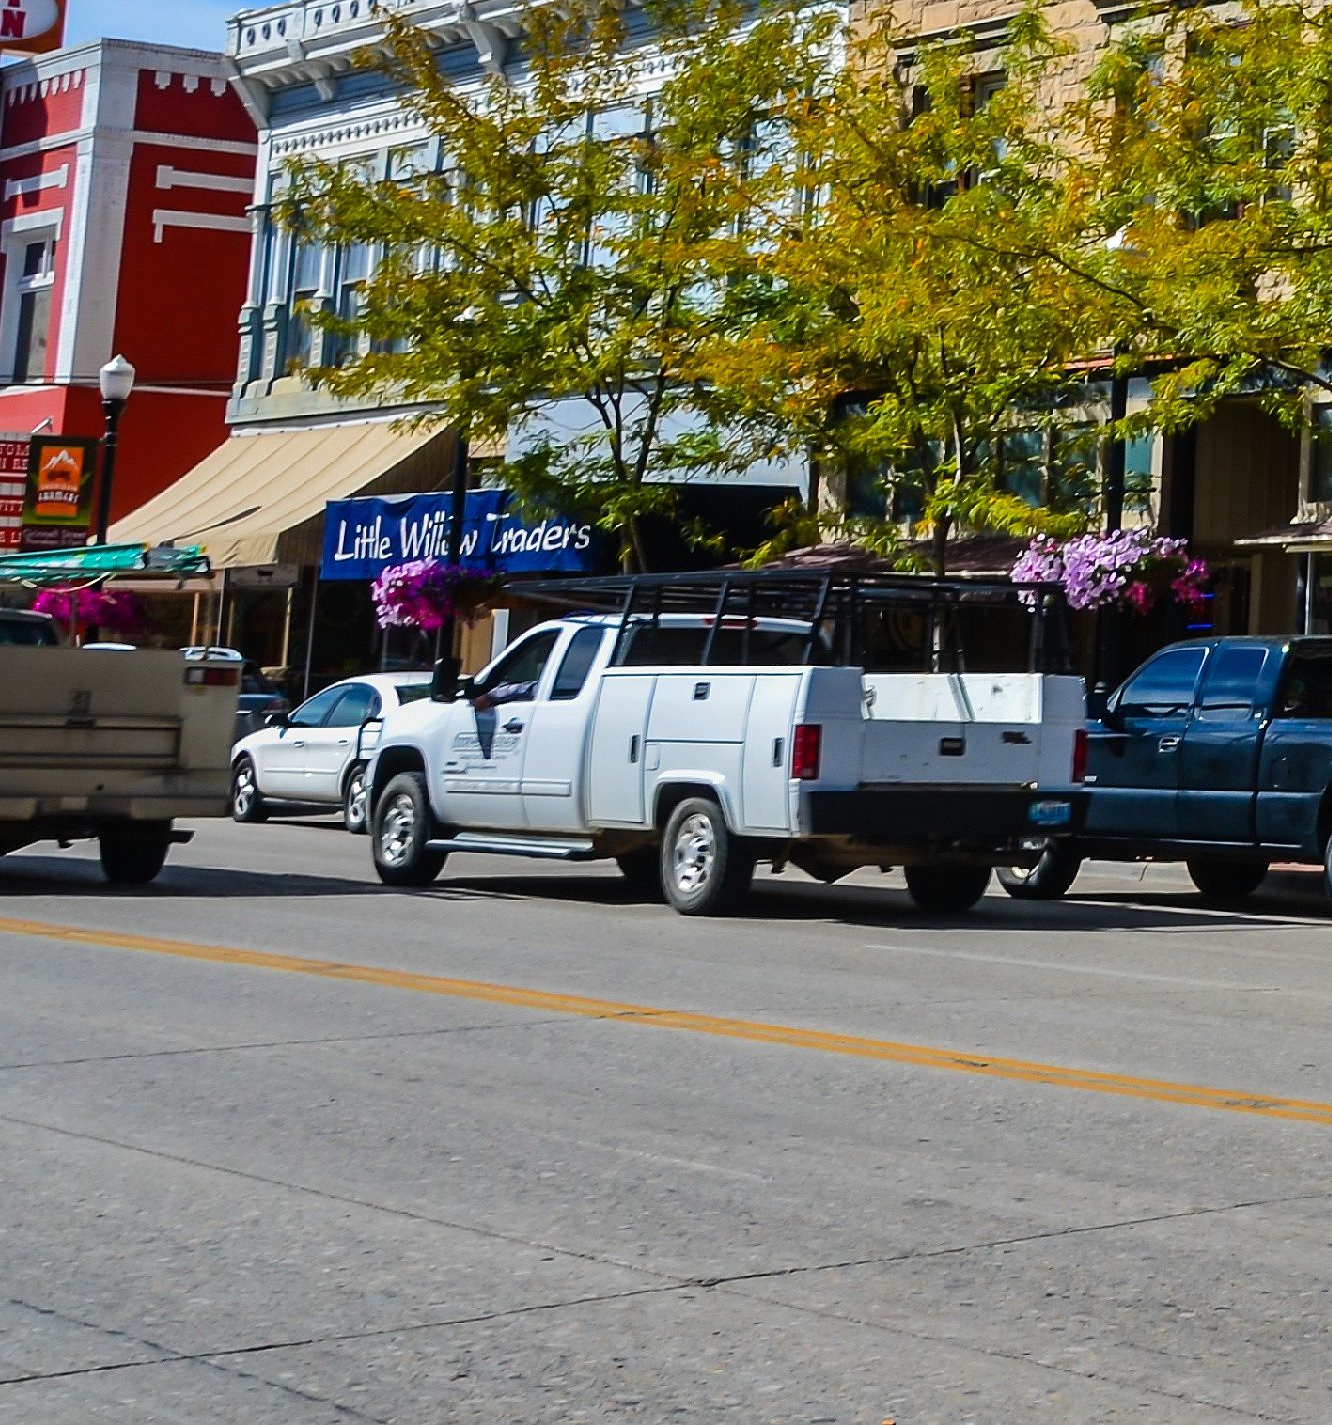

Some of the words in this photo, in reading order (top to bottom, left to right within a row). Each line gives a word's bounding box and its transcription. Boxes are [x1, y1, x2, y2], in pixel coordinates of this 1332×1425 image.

[334, 515, 393, 562] Little
[400, 510, 478, 559] Willw
[486, 512, 592, 554] Traders
